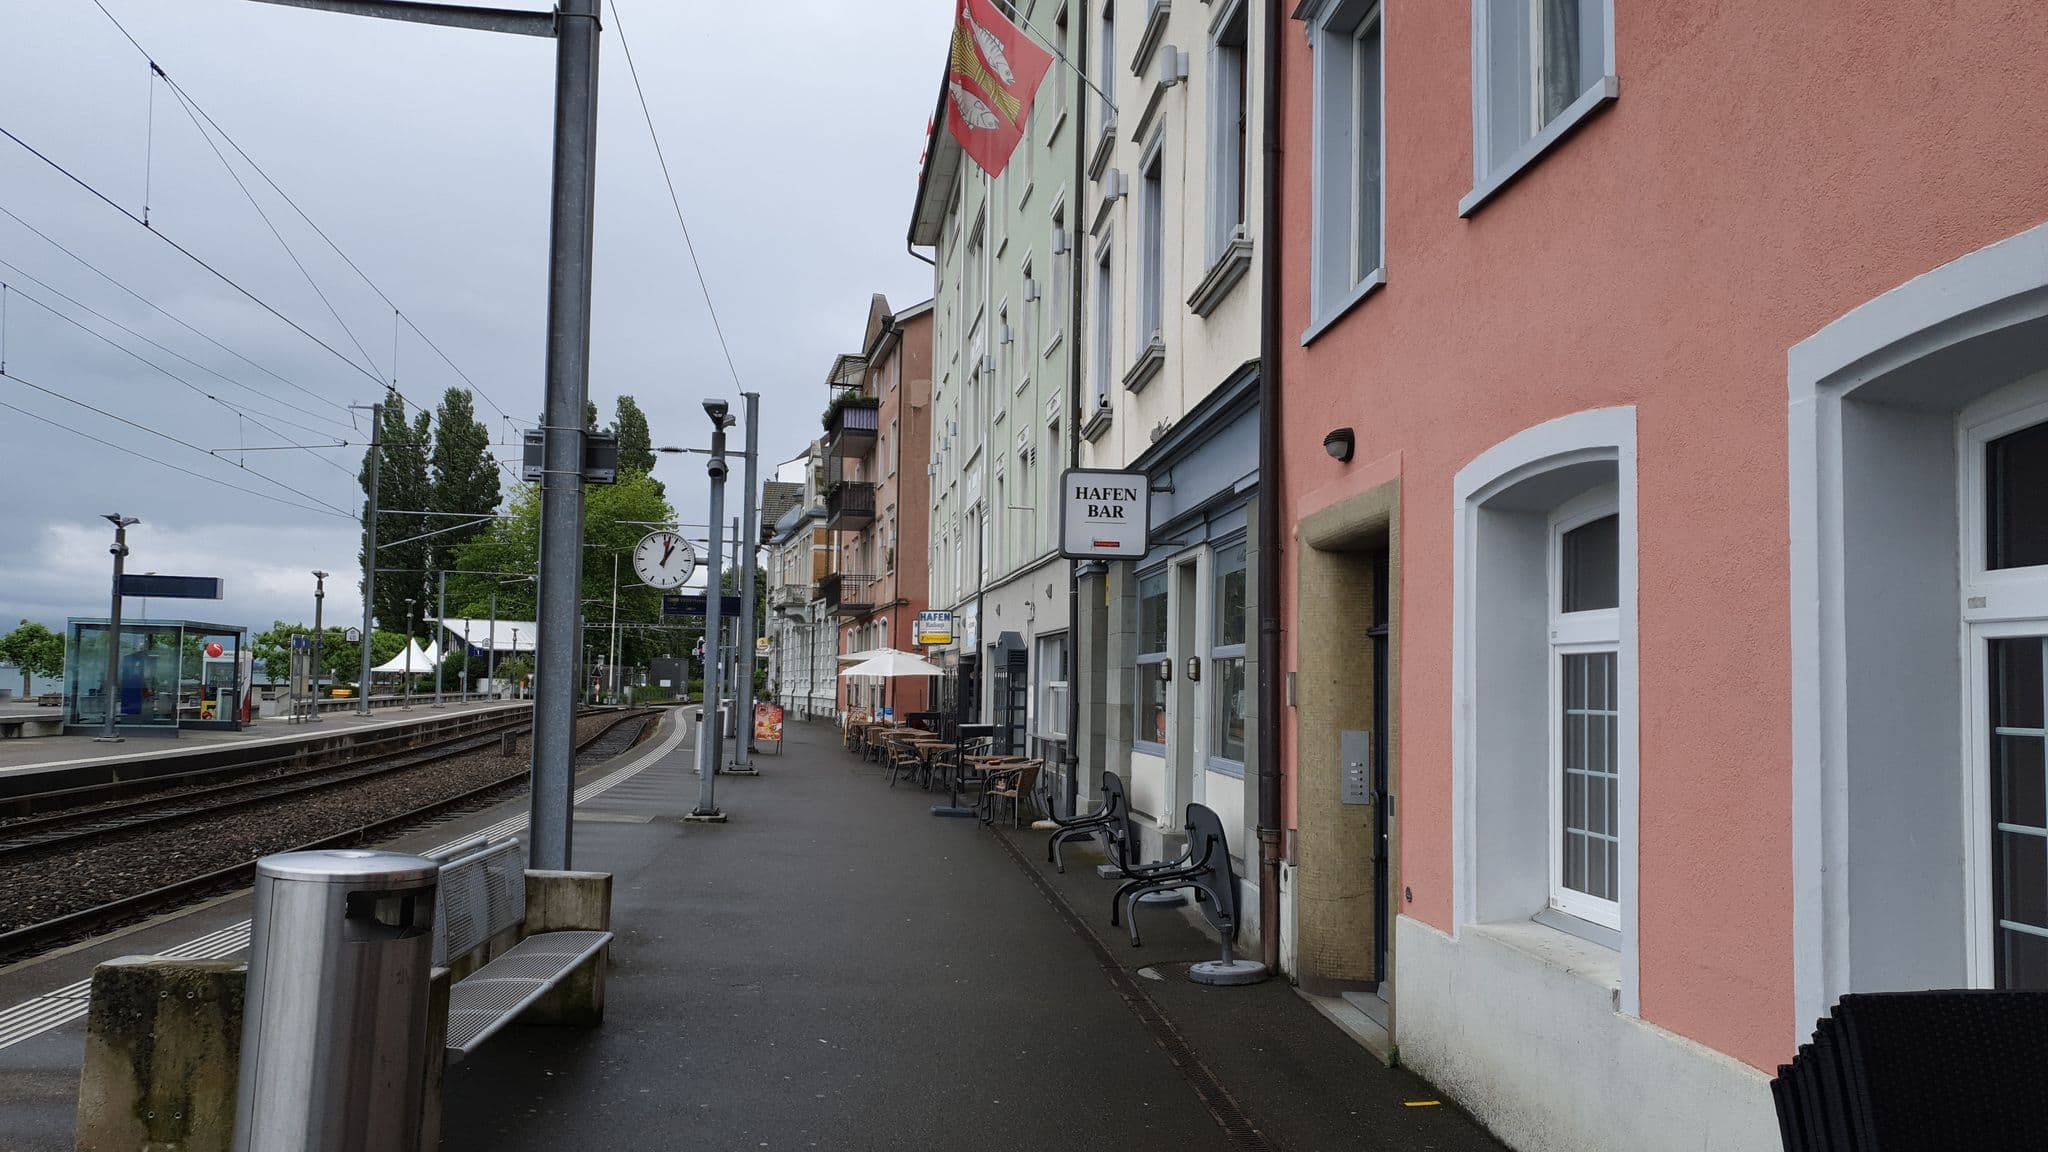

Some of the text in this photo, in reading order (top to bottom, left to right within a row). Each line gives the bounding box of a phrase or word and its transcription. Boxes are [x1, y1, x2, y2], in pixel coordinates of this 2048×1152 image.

[1075, 487, 1137, 501] HAFEN
[1088, 504, 1124, 518] BAR
[920, 613, 950, 621] HAFEN
